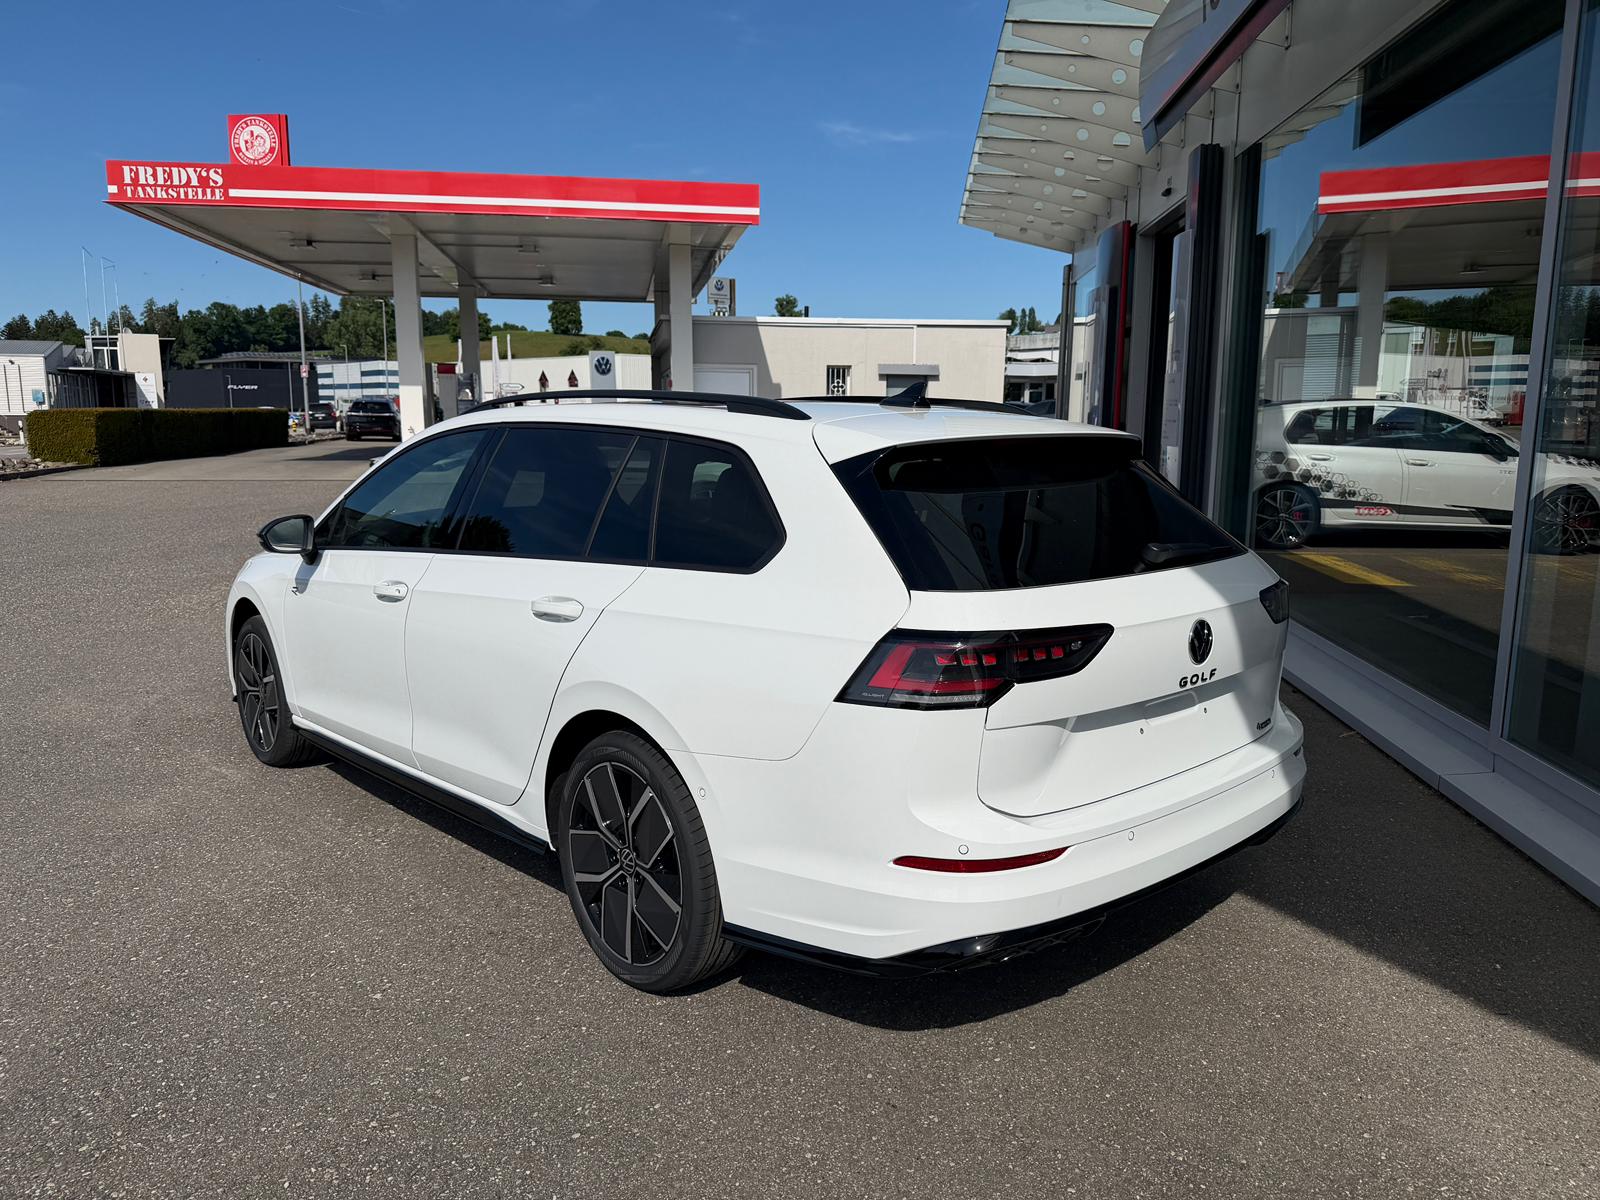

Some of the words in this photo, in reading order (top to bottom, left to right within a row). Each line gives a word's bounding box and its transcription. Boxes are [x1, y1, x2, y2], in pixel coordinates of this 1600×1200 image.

[122, 165, 224, 187] FREDY'S
[124, 186, 224, 200] TANKSTELLE
[1179, 668, 1217, 689] GOLF
